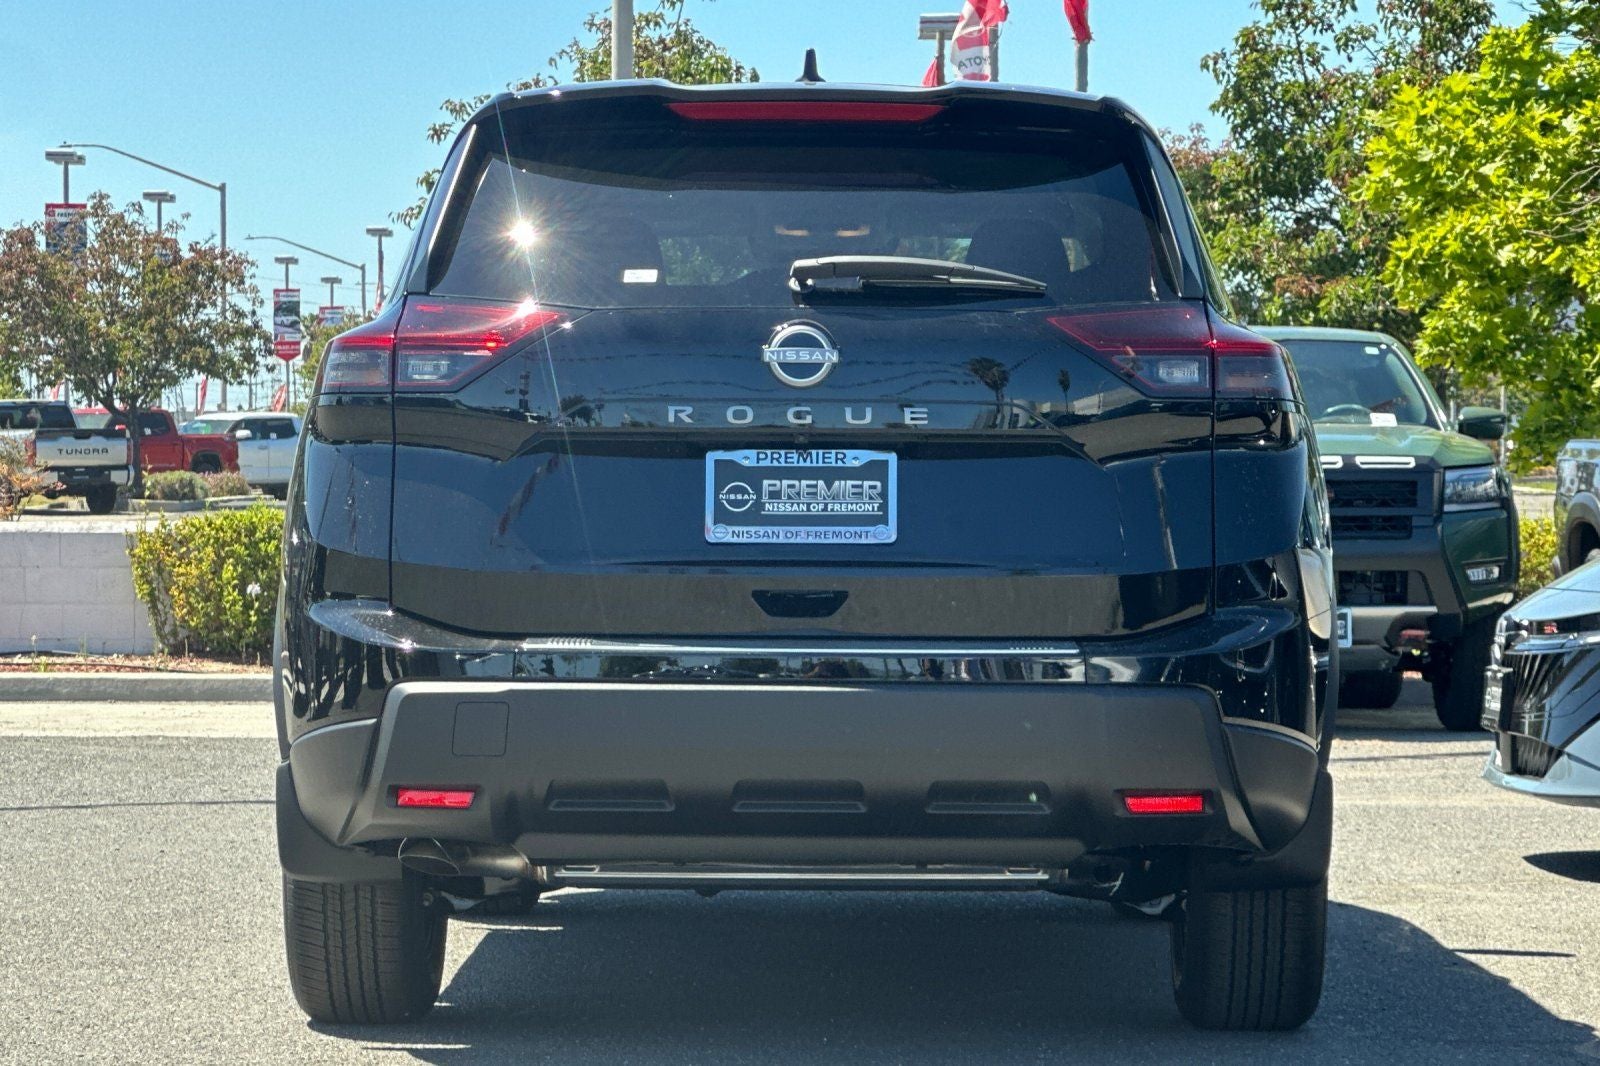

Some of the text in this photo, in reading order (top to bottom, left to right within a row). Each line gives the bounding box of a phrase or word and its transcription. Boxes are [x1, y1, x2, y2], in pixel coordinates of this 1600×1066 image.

[765, 350, 837, 361] NISSAN
[667, 405, 929, 425] ROGUE
[57, 447, 109, 455] TUNDRA
[755, 450, 847, 465] PREMIER
[762, 479, 883, 501] PREMIER
[765, 502, 880, 512] NISSAN OF FREMONT
[731, 529, 781, 540] NISSAN
[784, 529, 803, 540] OF
[805, 530, 871, 541] FREMONT
